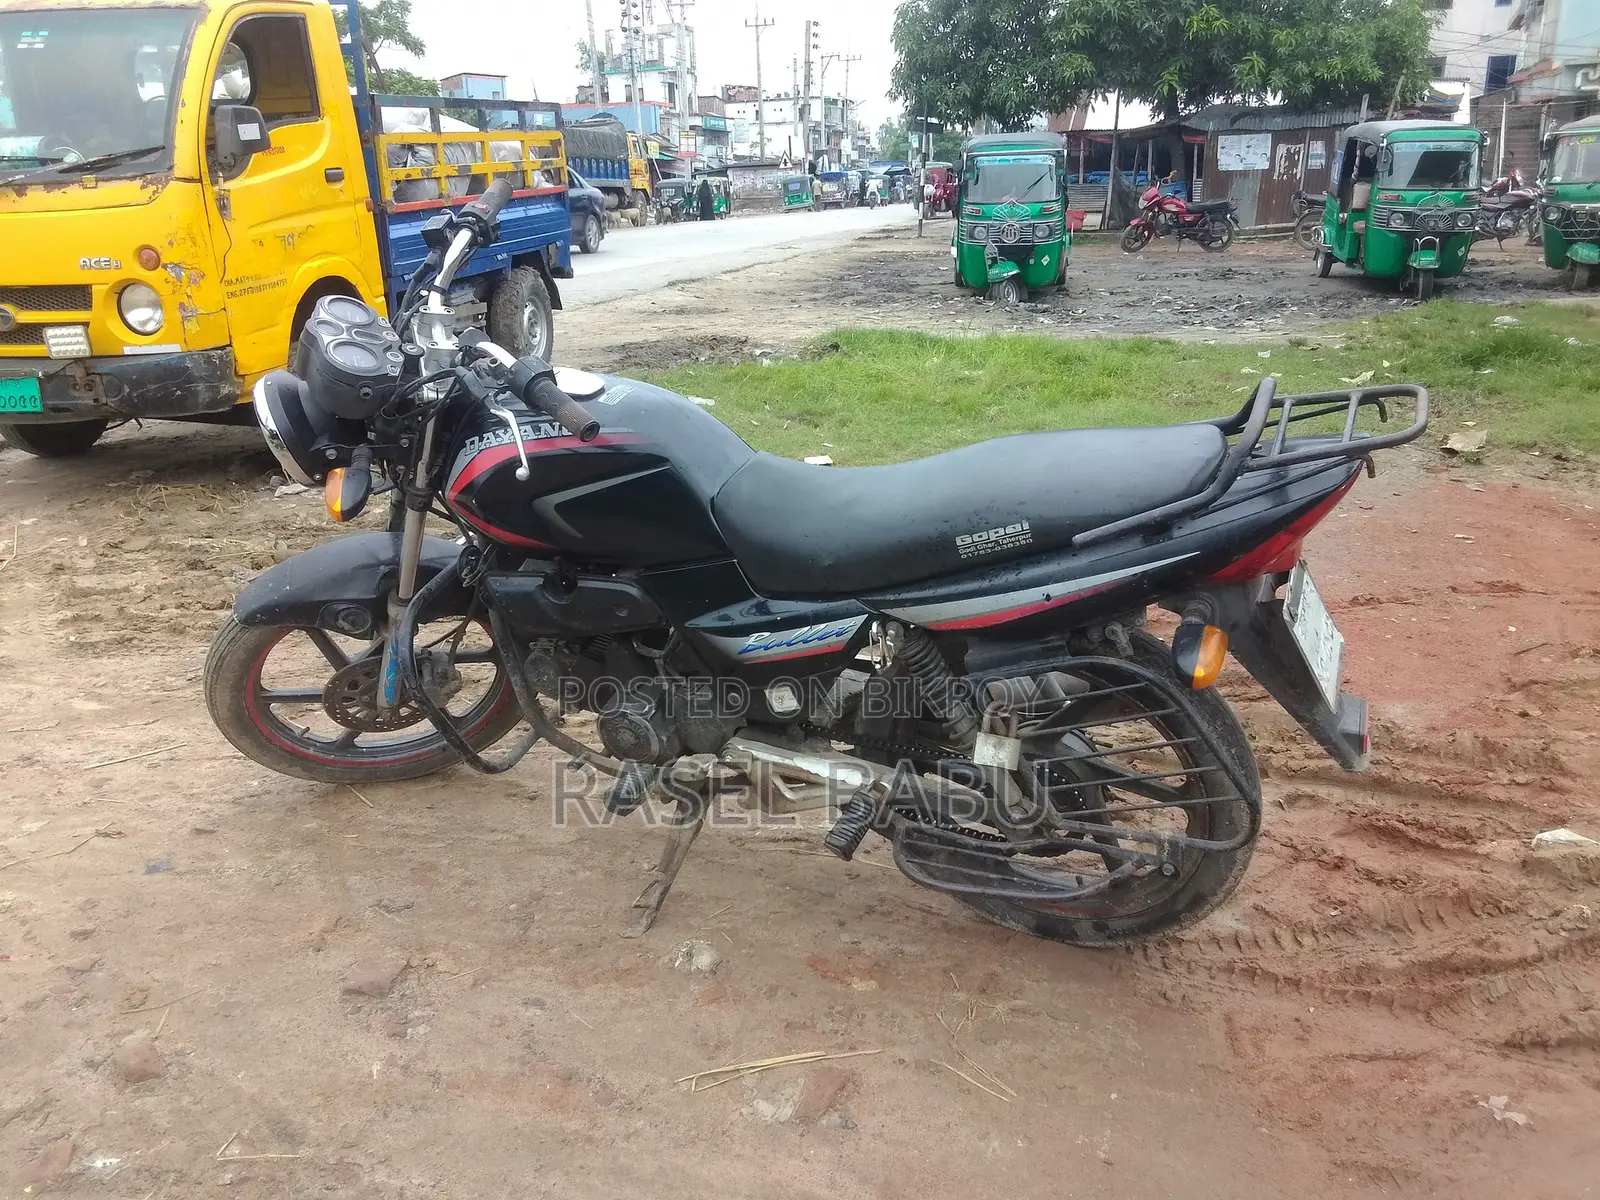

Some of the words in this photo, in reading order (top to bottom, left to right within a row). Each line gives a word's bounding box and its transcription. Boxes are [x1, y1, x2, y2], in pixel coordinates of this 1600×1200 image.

[80, 257, 111, 270] ACE
[955, 520, 1030, 546] Gopal
[998, 533, 1032, 545] Taherpur
[737, 621, 857, 655] Bullet
